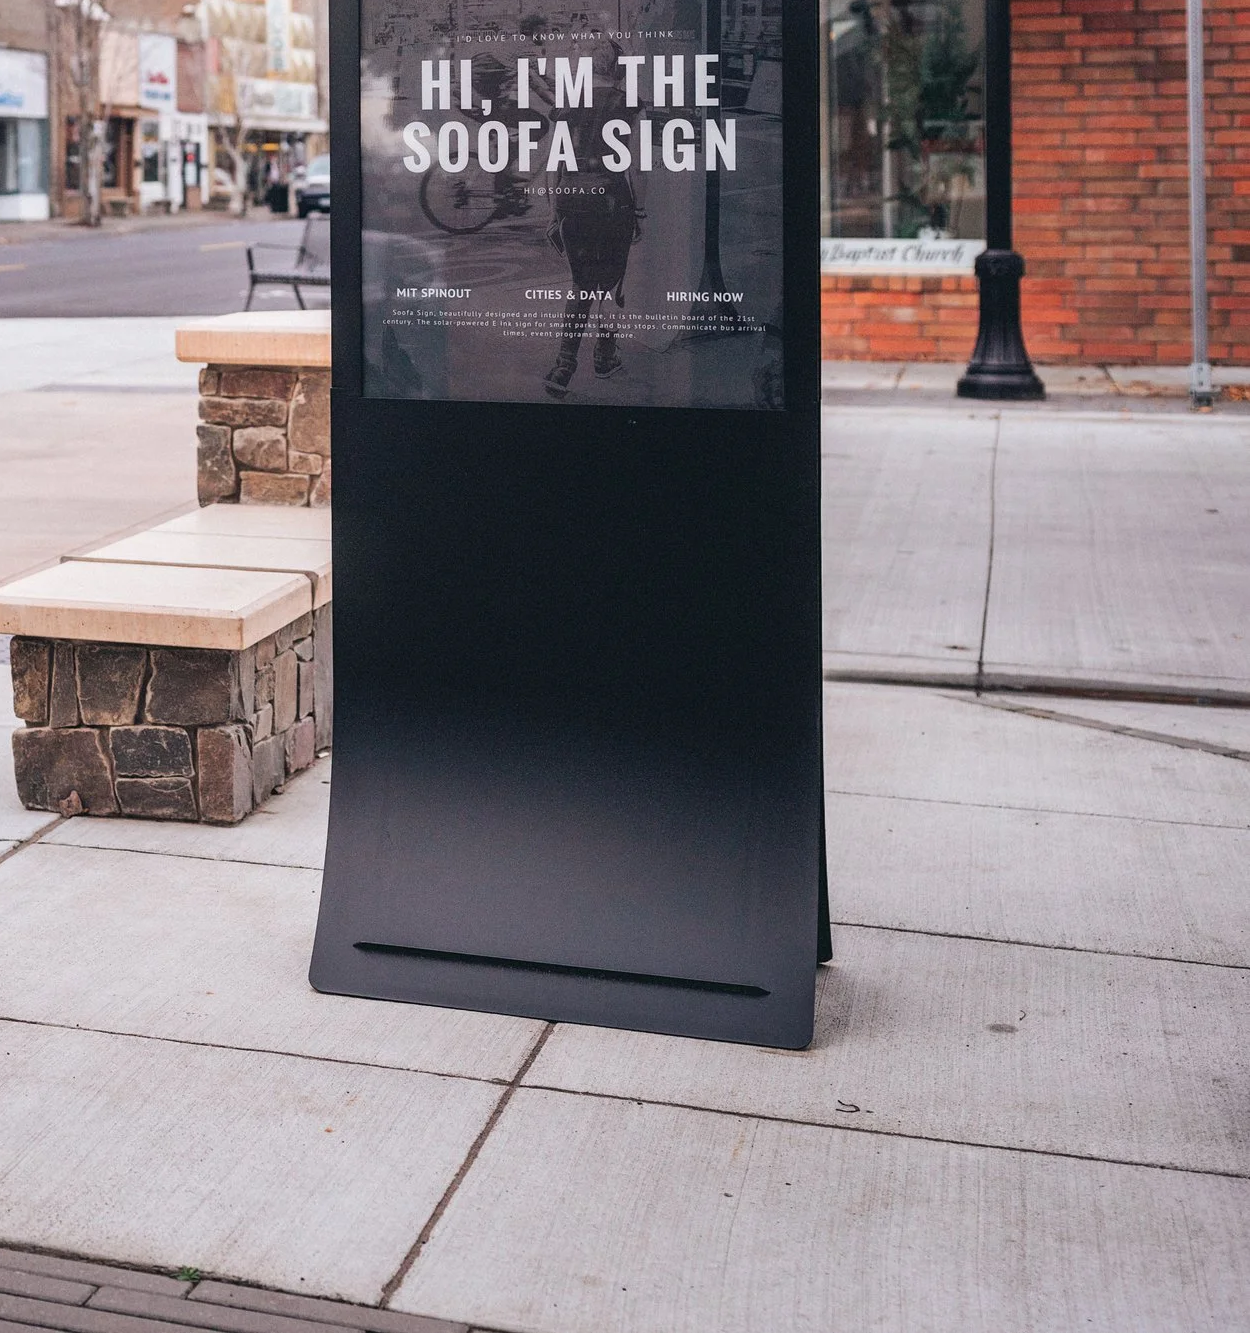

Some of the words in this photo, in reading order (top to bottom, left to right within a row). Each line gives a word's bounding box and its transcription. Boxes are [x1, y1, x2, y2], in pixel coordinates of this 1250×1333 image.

[456, 34, 472, 43] I'D
[478, 34, 506, 42] LOVE
[512, 34, 526, 42] TO
[532, 33, 565, 41] KNOW
[571, 32, 602, 40] WHAT
[608, 31, 631, 39] YOU
[638, 30, 674, 39] THINK
[421, 59, 492, 116] HI,
[517, 56, 593, 109] I'M
[618, 54, 719, 108] THE
[402, 120, 578, 173] SOOFA
[601, 118, 736, 173] SIGN
[523, 186, 606, 195] HI@SOOFA.CO
[396, 287, 417, 298] MIT
[421, 287, 472, 299] SPINOUT
[524, 289, 562, 300] CITIES
[566, 290, 576, 301] &
[580, 290, 613, 301] DATA
[666, 291, 710, 302] HIRING
[713, 292, 744, 303] NOW
[392, 309, 414, 317] Soofa
[439, 309, 482, 319] beautifully
[485, 311, 521, 320] designed
[645, 313, 678, 321] bulletin
[708, 314, 717, 322] of
[433, 319, 489, 328] solar-powered
[515, 321, 532, 329] sign
[574, 322, 596, 330] parks
[634, 323, 659, 331] stops.
[661, 323, 717, 331] Communicate
[720, 324, 735, 332] bus
[555, 331, 593, 340] programs
